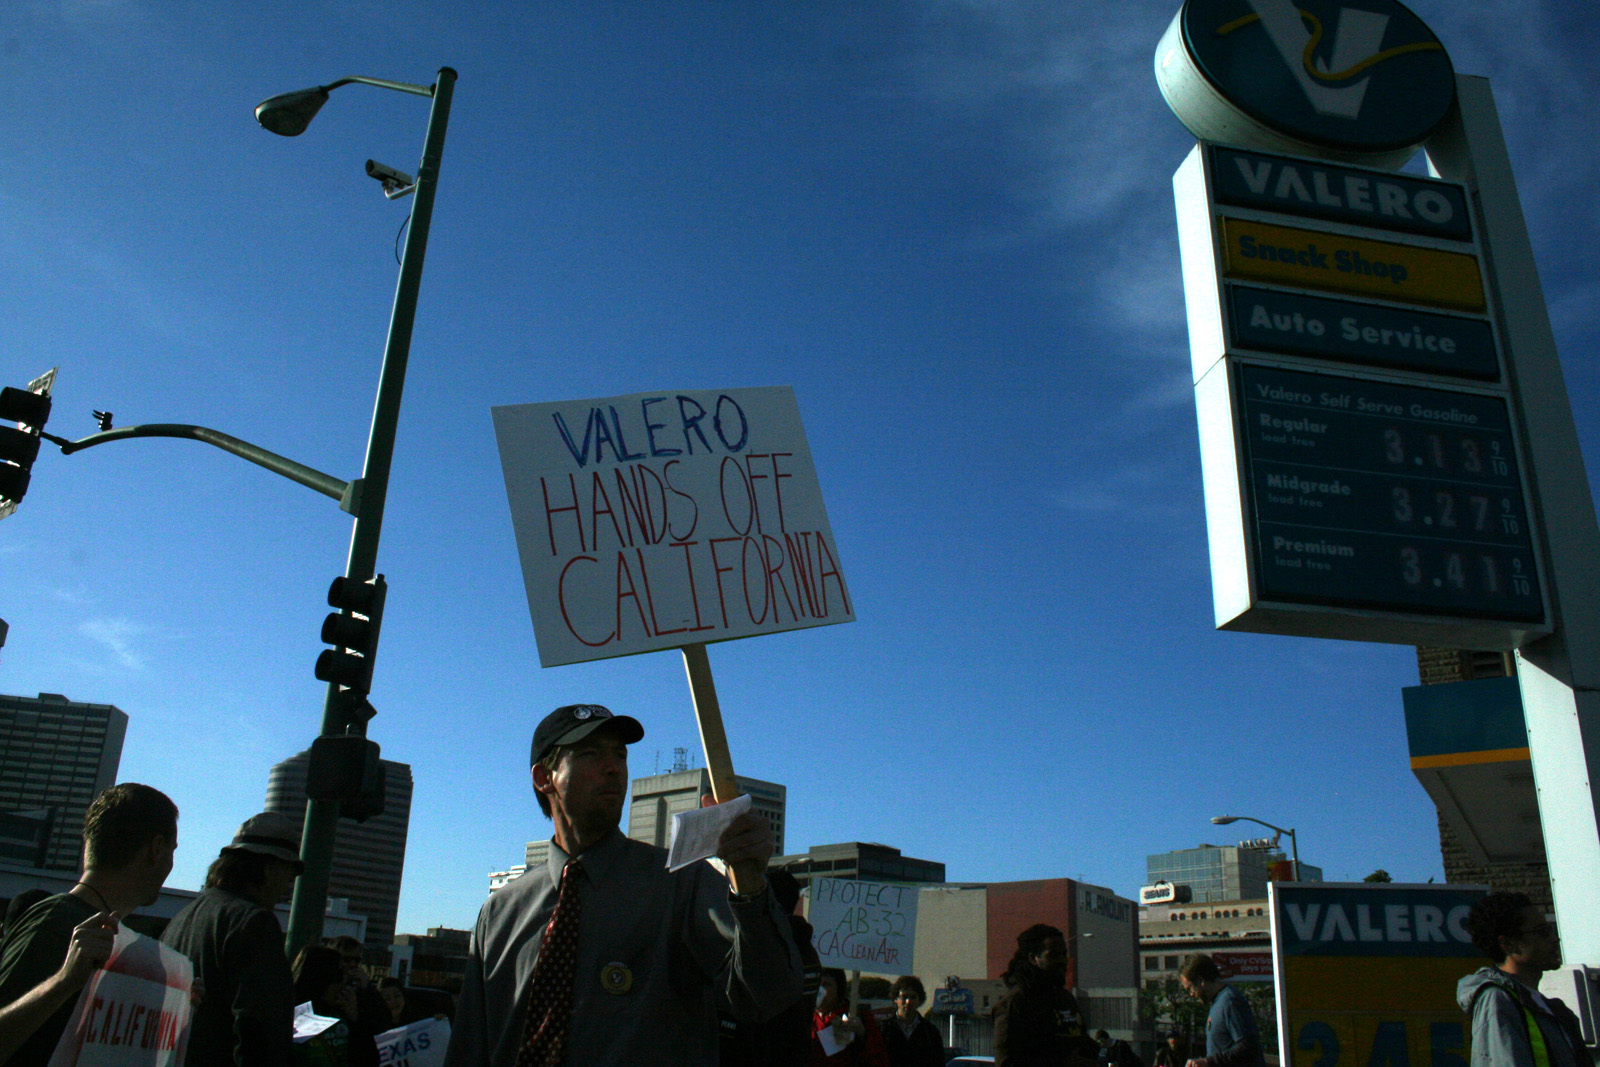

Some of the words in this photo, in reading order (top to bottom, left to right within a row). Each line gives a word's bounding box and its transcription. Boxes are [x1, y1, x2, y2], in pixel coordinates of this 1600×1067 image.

[1233, 157, 1453, 224] VALERO
[1238, 234, 1328, 270] Snack
[1335, 249, 1408, 284] Shop
[1250, 305, 1325, 336] Auto
[1341, 317, 1457, 354] Service
[1257, 384, 1312, 403] Valero
[1320, 392, 1352, 409] Self
[1357, 397, 1403, 415] Serve
[1410, 404, 1478, 424] Gasoline
[1259, 413, 1328, 434] Regular
[552, 395, 748, 468] VALERO
[1261, 431, 1286, 446] lead
[540, 460, 698, 556] HANDS
[720, 453, 793, 537] OFF
[1267, 474, 1351, 495] Midgrade
[1273, 536, 1354, 557] Premium
[559, 531, 850, 647] CALIFORNIA
[817, 879, 911, 908] PROTECT
[86, 997, 178, 1051] CALIFORNIA
